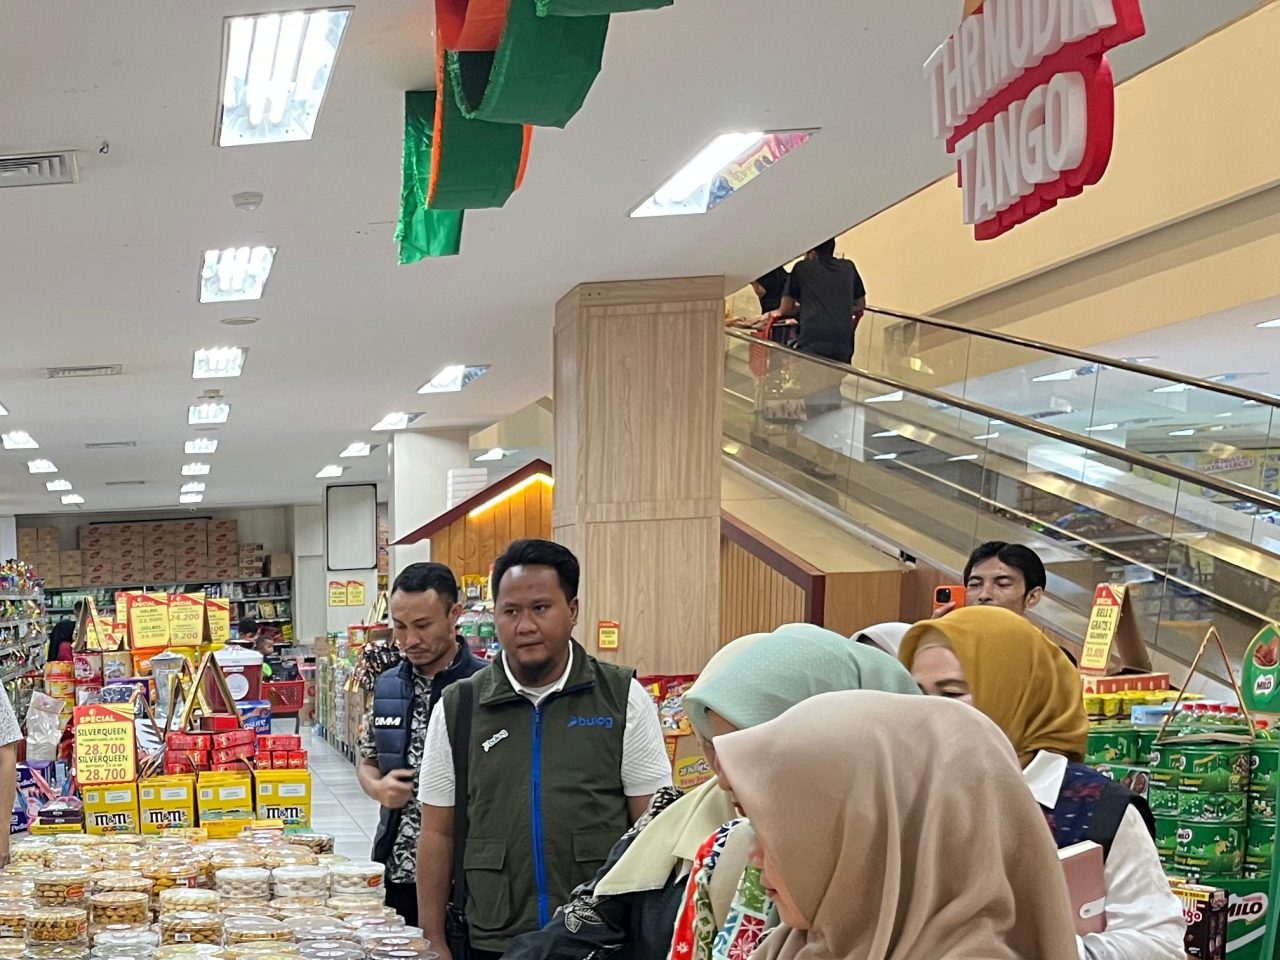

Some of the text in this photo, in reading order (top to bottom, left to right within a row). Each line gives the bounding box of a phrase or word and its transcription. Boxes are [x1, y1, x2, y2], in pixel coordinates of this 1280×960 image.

[955, 71, 1088, 225] TANGO
[78, 728, 127, 736] SILVERQUEEN
[85, 744, 126, 756] 28.700
[78, 755, 128, 763] SILVERQUEEN
[86, 768, 127, 780] 28.700
